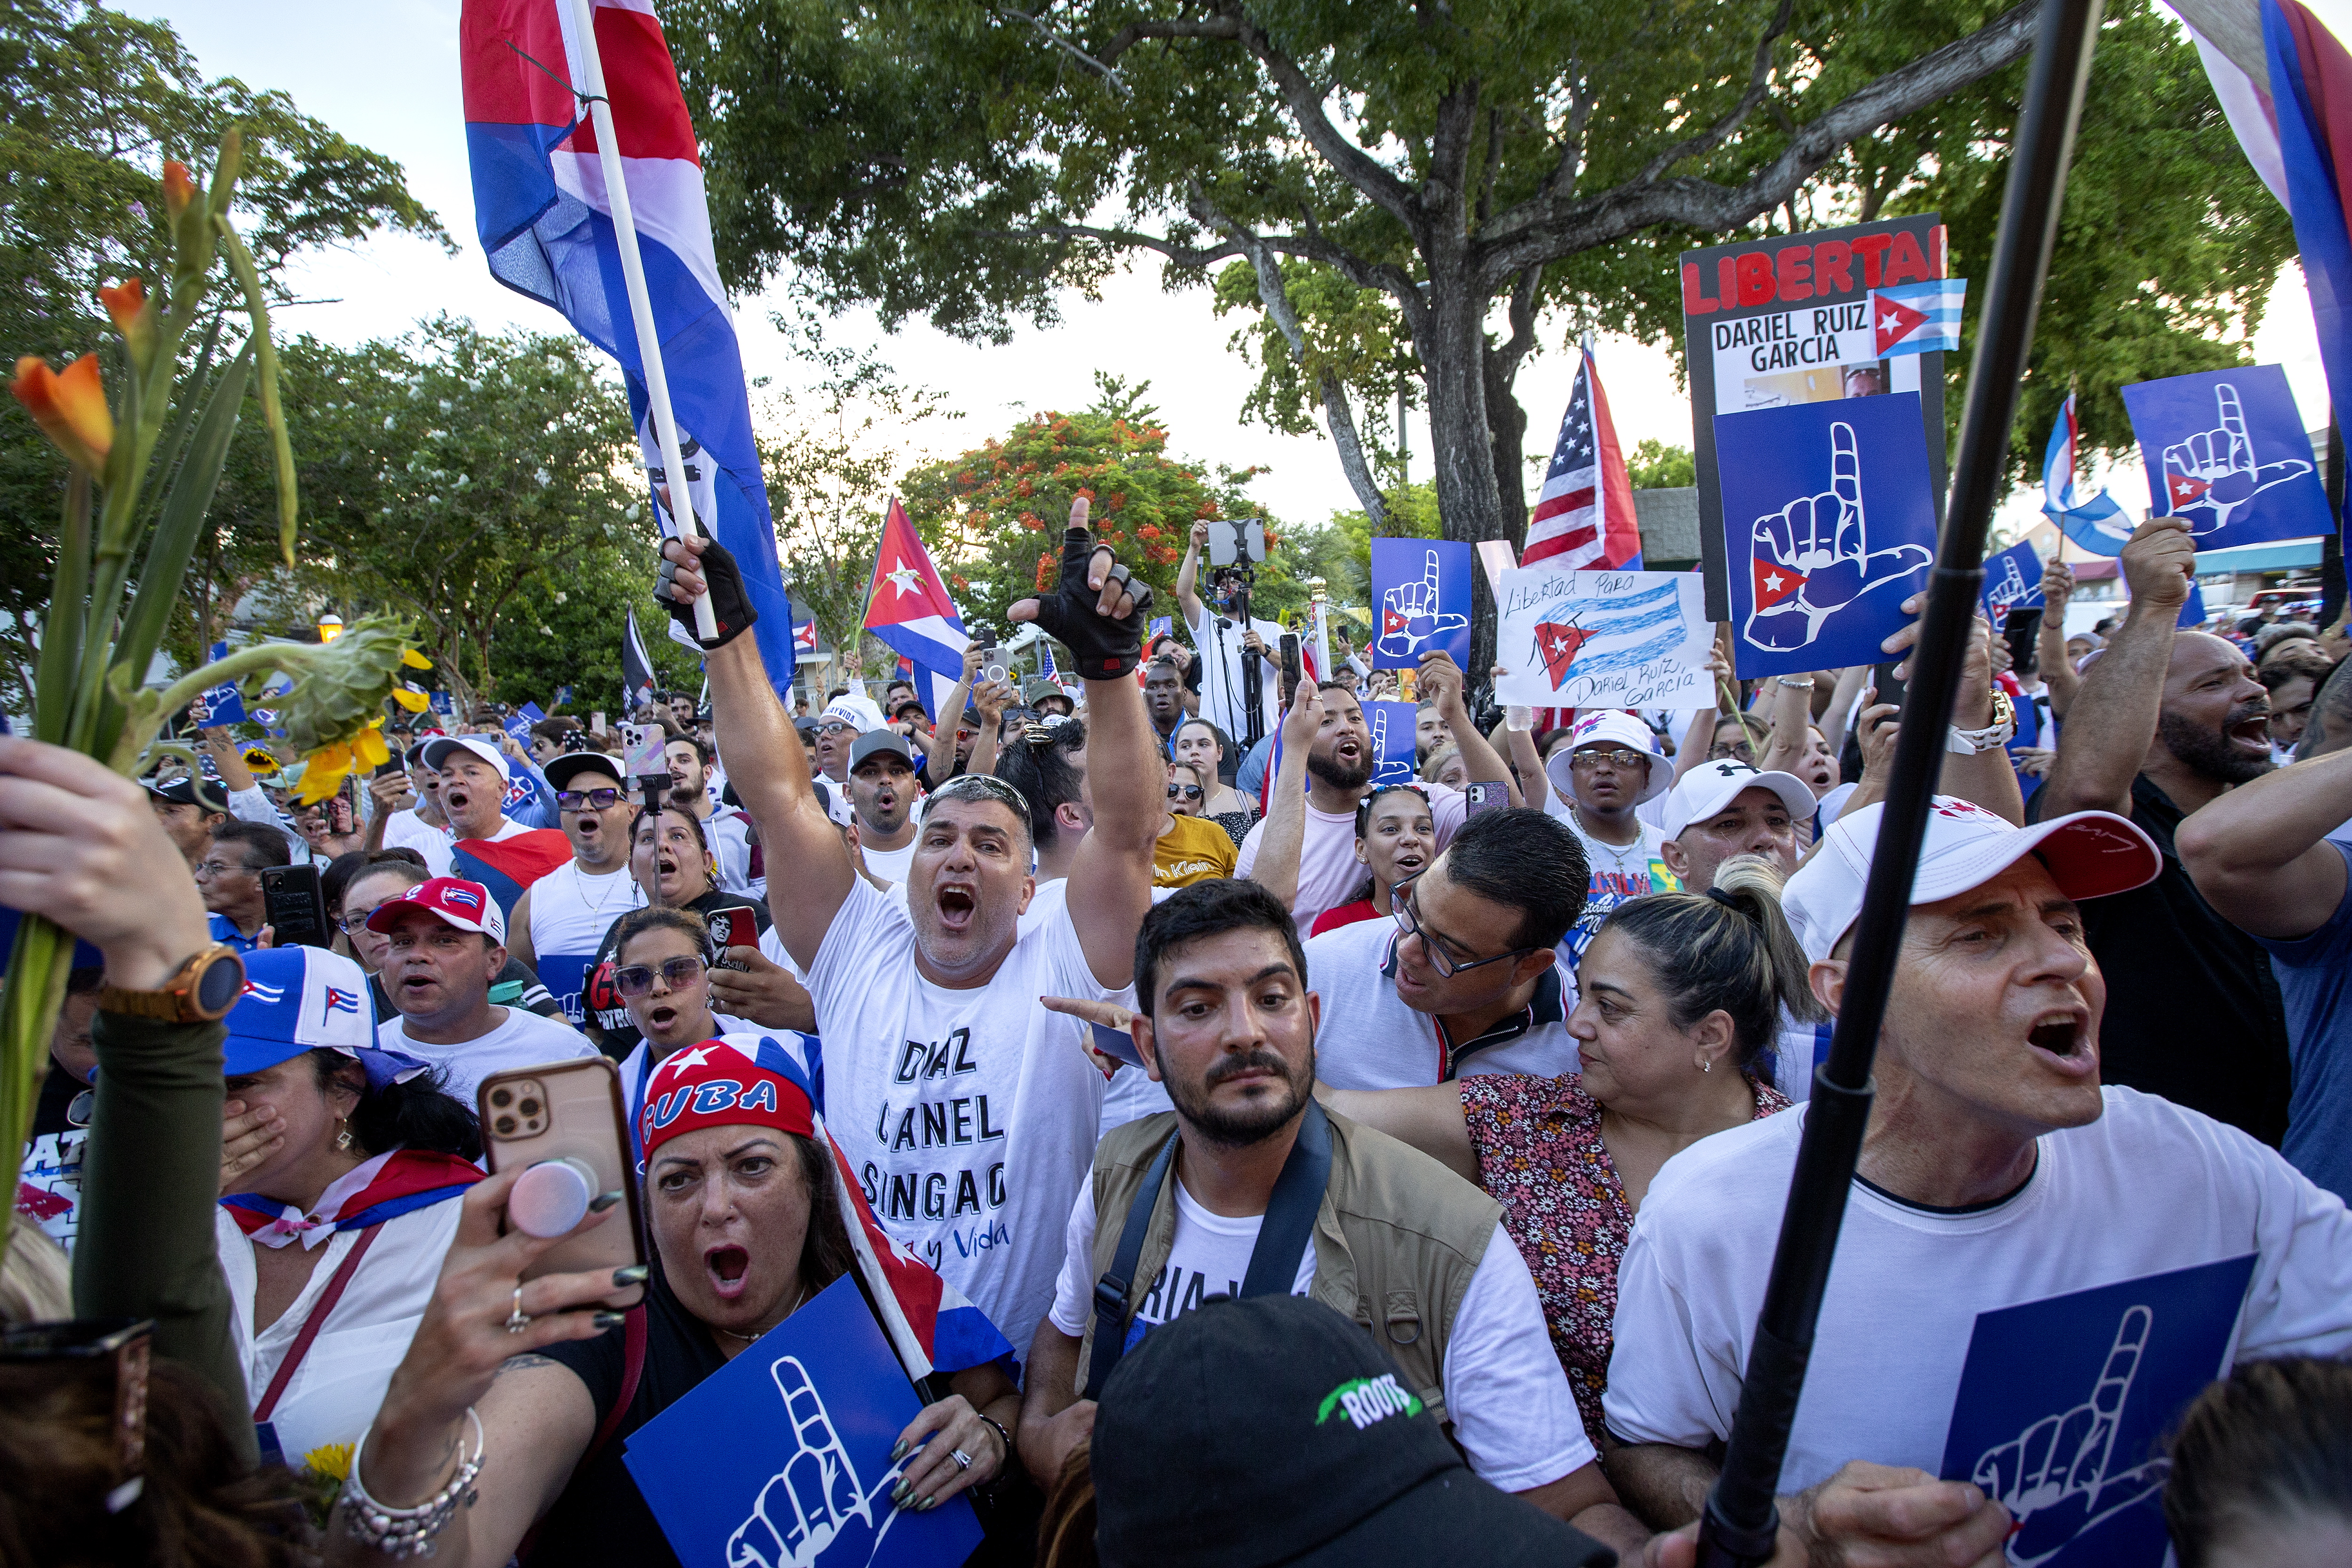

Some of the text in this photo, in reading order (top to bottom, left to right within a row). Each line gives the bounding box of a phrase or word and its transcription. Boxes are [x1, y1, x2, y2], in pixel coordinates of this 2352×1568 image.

[1716, 303, 1868, 350] DARIEL RUIZ
[1751, 334, 1840, 371] GARCIA
[1170, 860, 1215, 878] Klein
[894, 1027, 976, 1084] DIAZ
[643, 1079, 776, 1144] CUBA
[876, 1095, 1004, 1152] CANEL
[954, 1220, 1009, 1258] Vida
[1341, 1373, 1410, 1431] ROOTS
